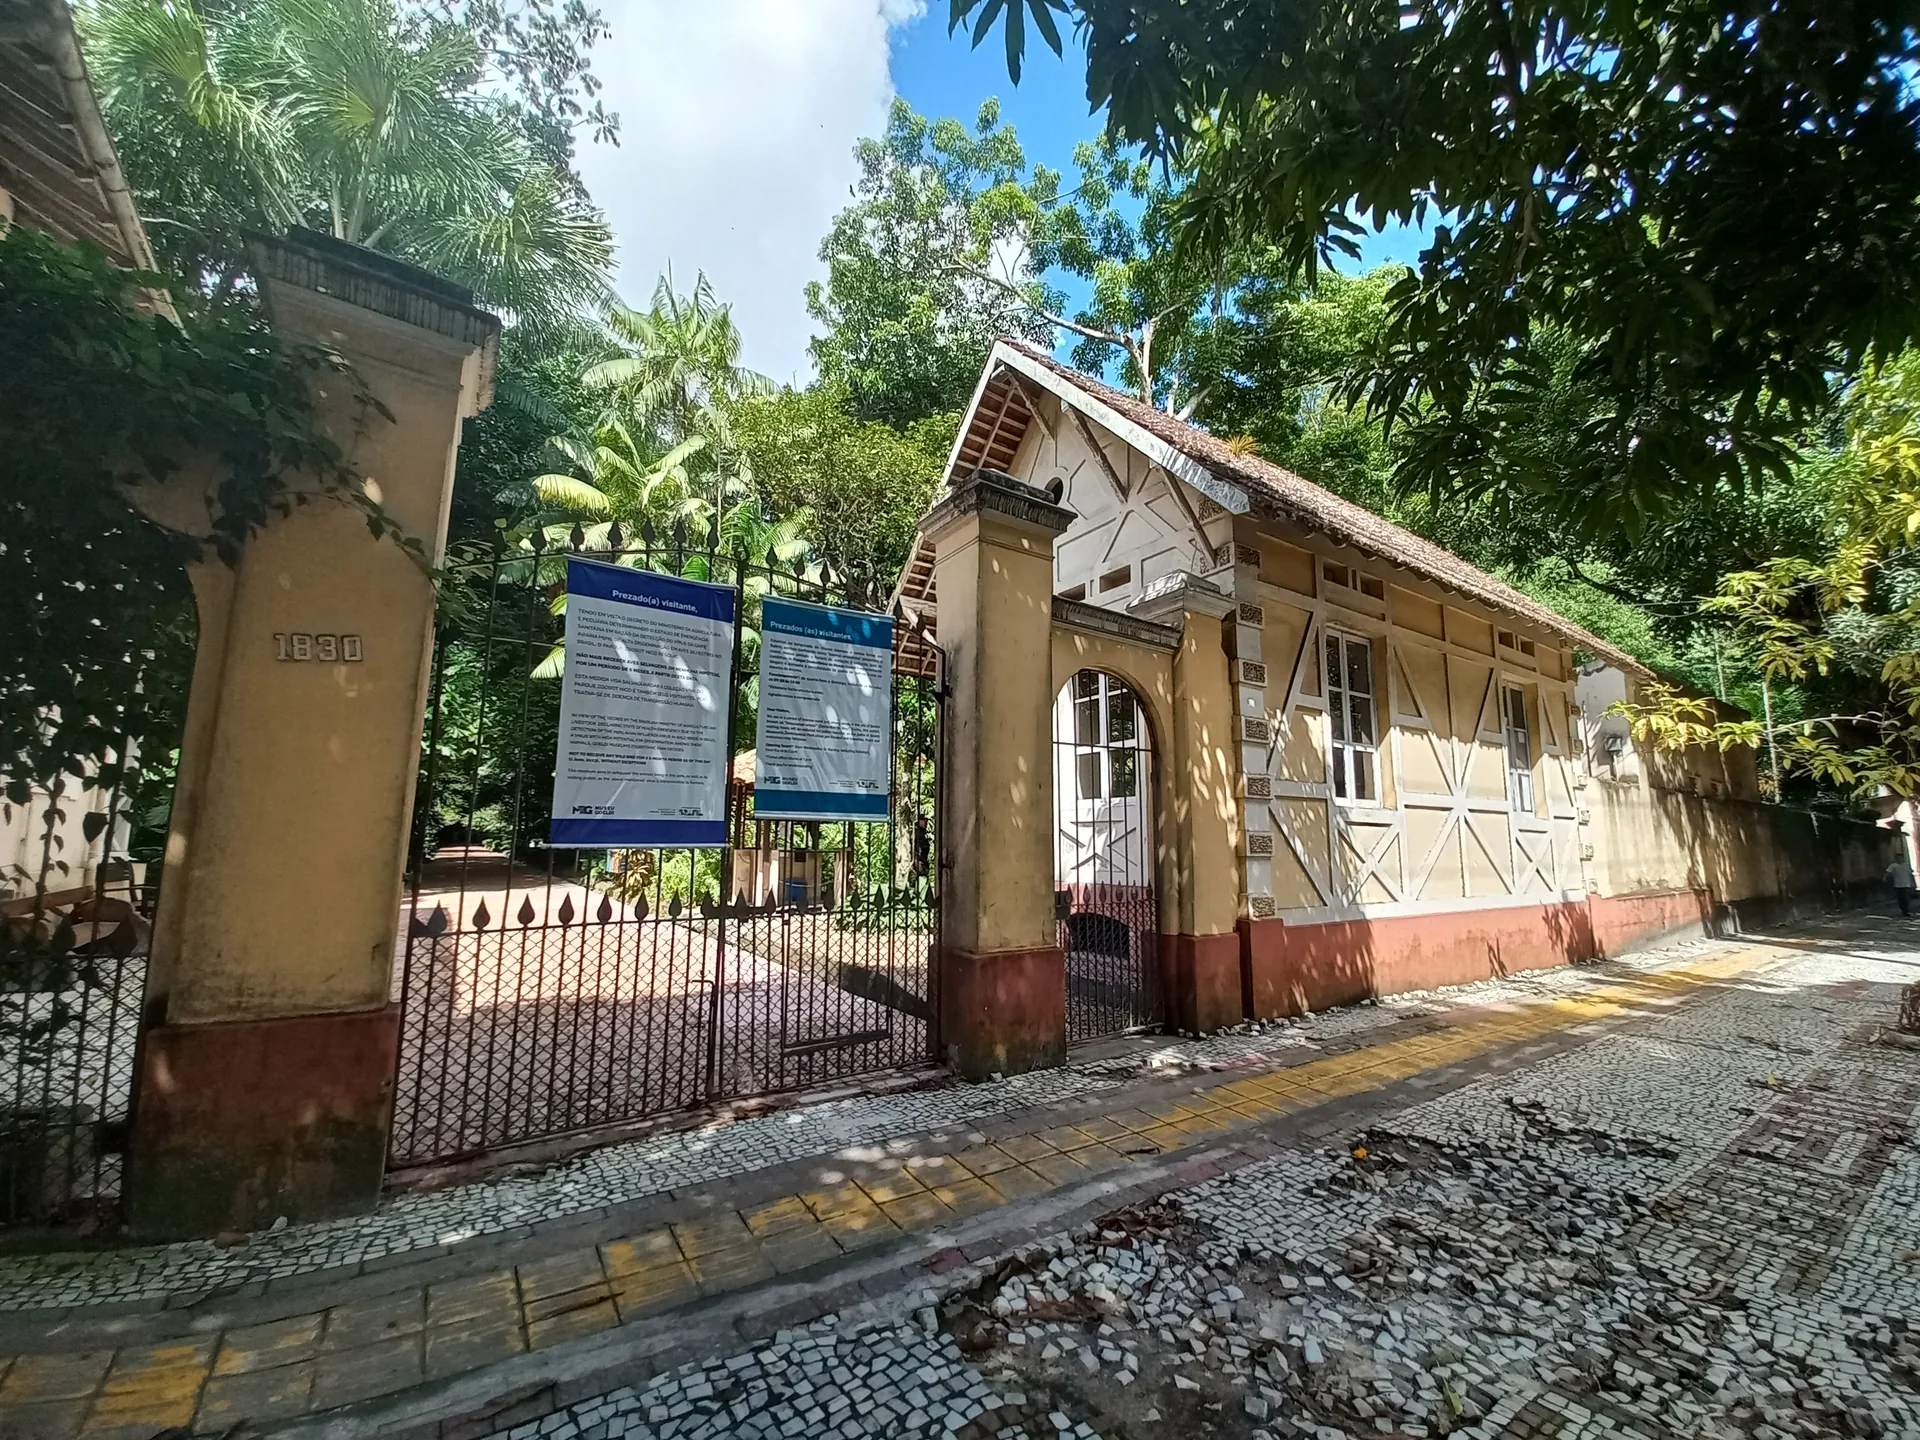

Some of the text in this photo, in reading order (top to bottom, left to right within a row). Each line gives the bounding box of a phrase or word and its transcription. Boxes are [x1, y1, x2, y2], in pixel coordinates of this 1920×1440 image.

[612, 590, 698, 613] Prezado(a) visitante,
[770, 621, 852, 641] Prezados (as) visitantes,
[274, 633, 362, 661] 1830
